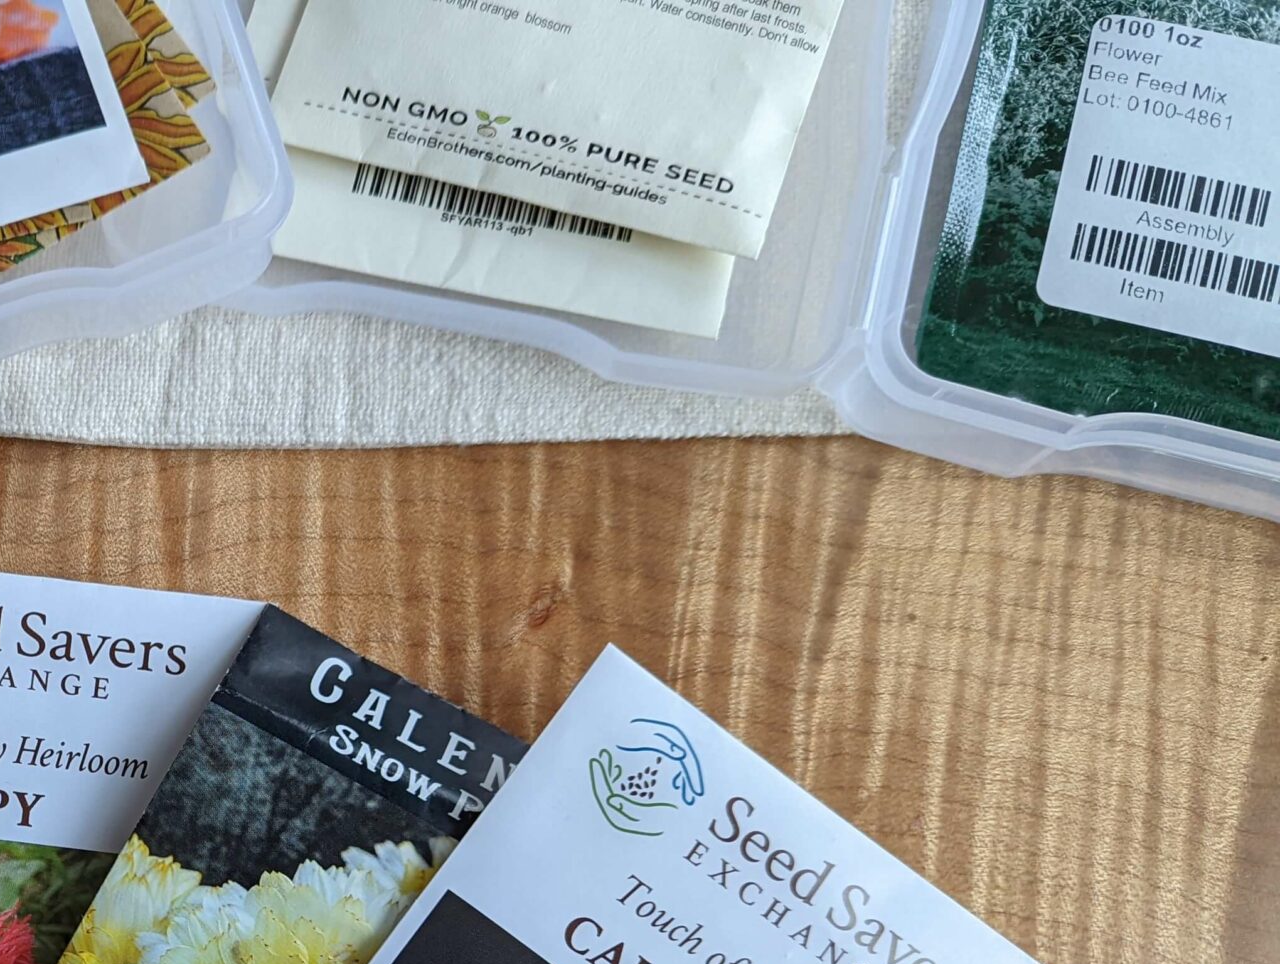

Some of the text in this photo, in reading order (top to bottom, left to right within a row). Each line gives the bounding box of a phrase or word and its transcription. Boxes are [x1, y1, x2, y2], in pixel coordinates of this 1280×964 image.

[479, 2, 520, 21] orange
[524, 11, 572, 35] blossom
[650, 0, 683, 16] Water
[685, 9, 754, 37] consistently.
[758, 27, 788, 45] Don't
[790, 36, 820, 54] allow
[722, 4, 749, 18] after
[751, 9, 771, 24] last
[1099, 17, 1203, 48] 0100 1oz
[1094, 41, 1163, 66] Flower
[1088, 64, 1227, 105] Bee Feed Mix
[1083, 87, 1234, 131] Lot: 0100-4861
[342, 86, 734, 194] NON GMO 100% PURE SEED
[387, 127, 668, 205] EdenBrothers.com/planting-guides
[1136, 210, 1234, 247] Assembly
[1120, 277, 1165, 303] Item
[16, 611, 188, 676] Savers
[13, 736, 149, 780] Heirloom
[329, 724, 442, 802] SNOW
[708, 796, 835, 907] Seed
[616, 874, 702, 956] Touch
